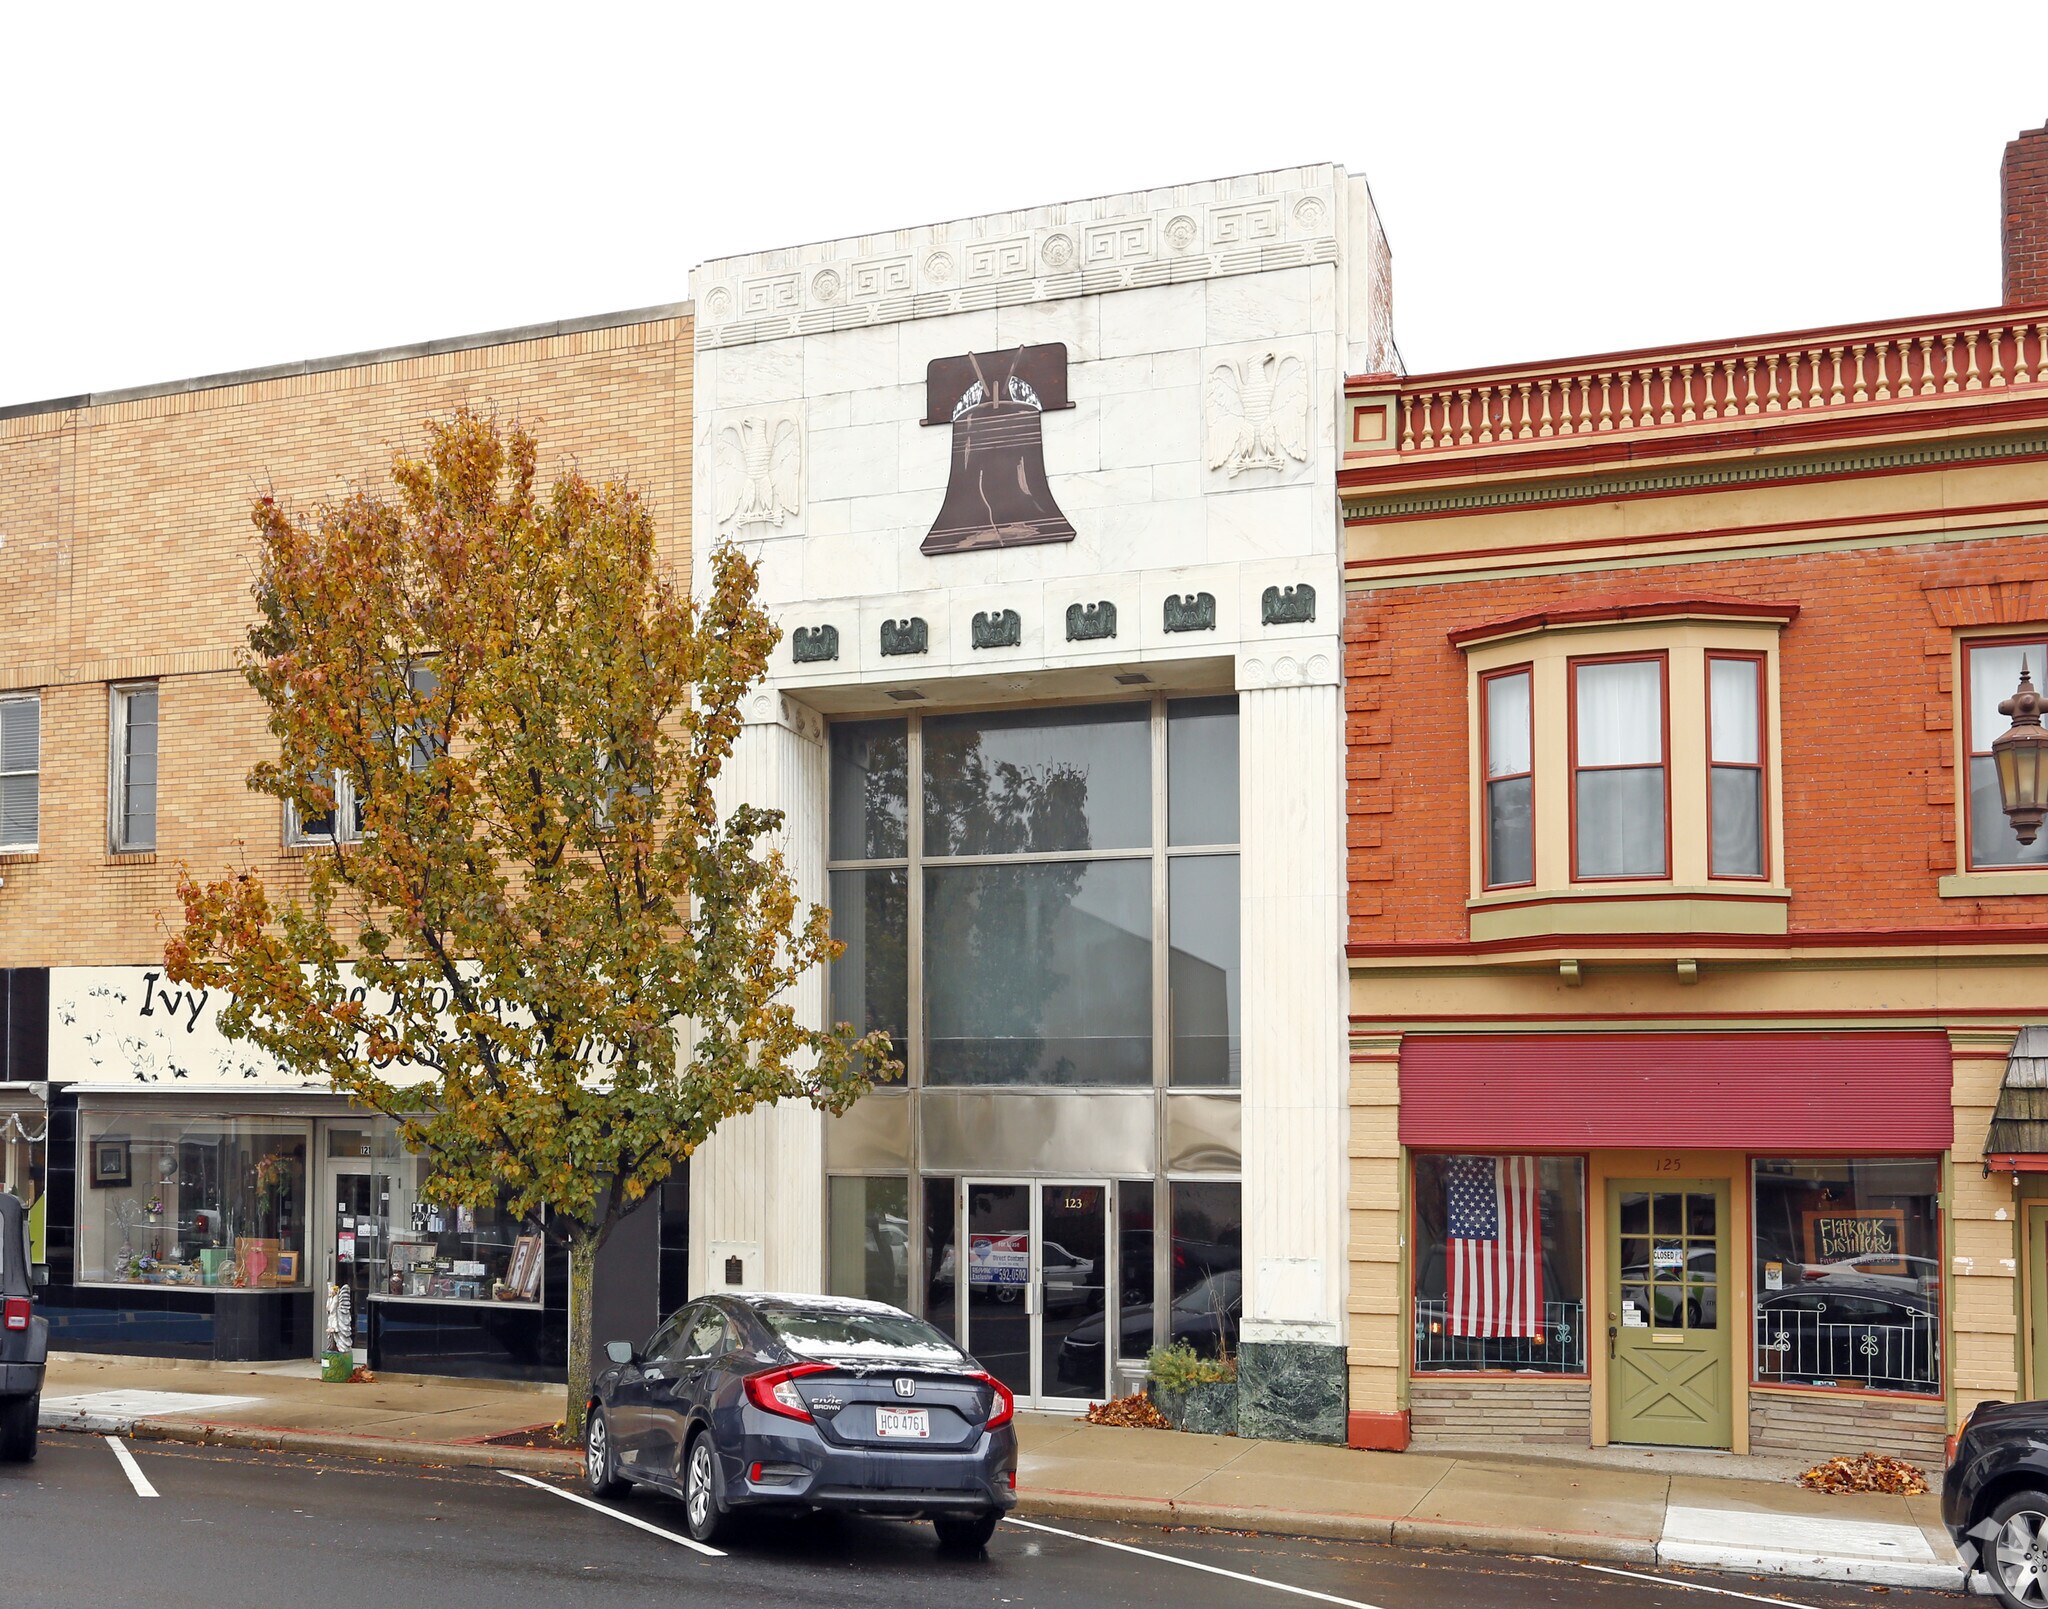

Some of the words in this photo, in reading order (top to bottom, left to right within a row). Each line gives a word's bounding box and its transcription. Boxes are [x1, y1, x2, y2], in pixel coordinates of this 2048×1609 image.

[139, 972, 208, 1034] Ivy
[361, 1146, 371, 1155] 121
[1656, 1158, 1681, 1171] 125
[412, 1203, 424, 1213] IT
[427, 1203, 439, 1213] IS
[1065, 1198, 1082, 1209] 123
[412, 1221, 424, 1231] IT
[1653, 1251, 1675, 1259] CLOSED
[902, 1416, 924, 1430] 4761
